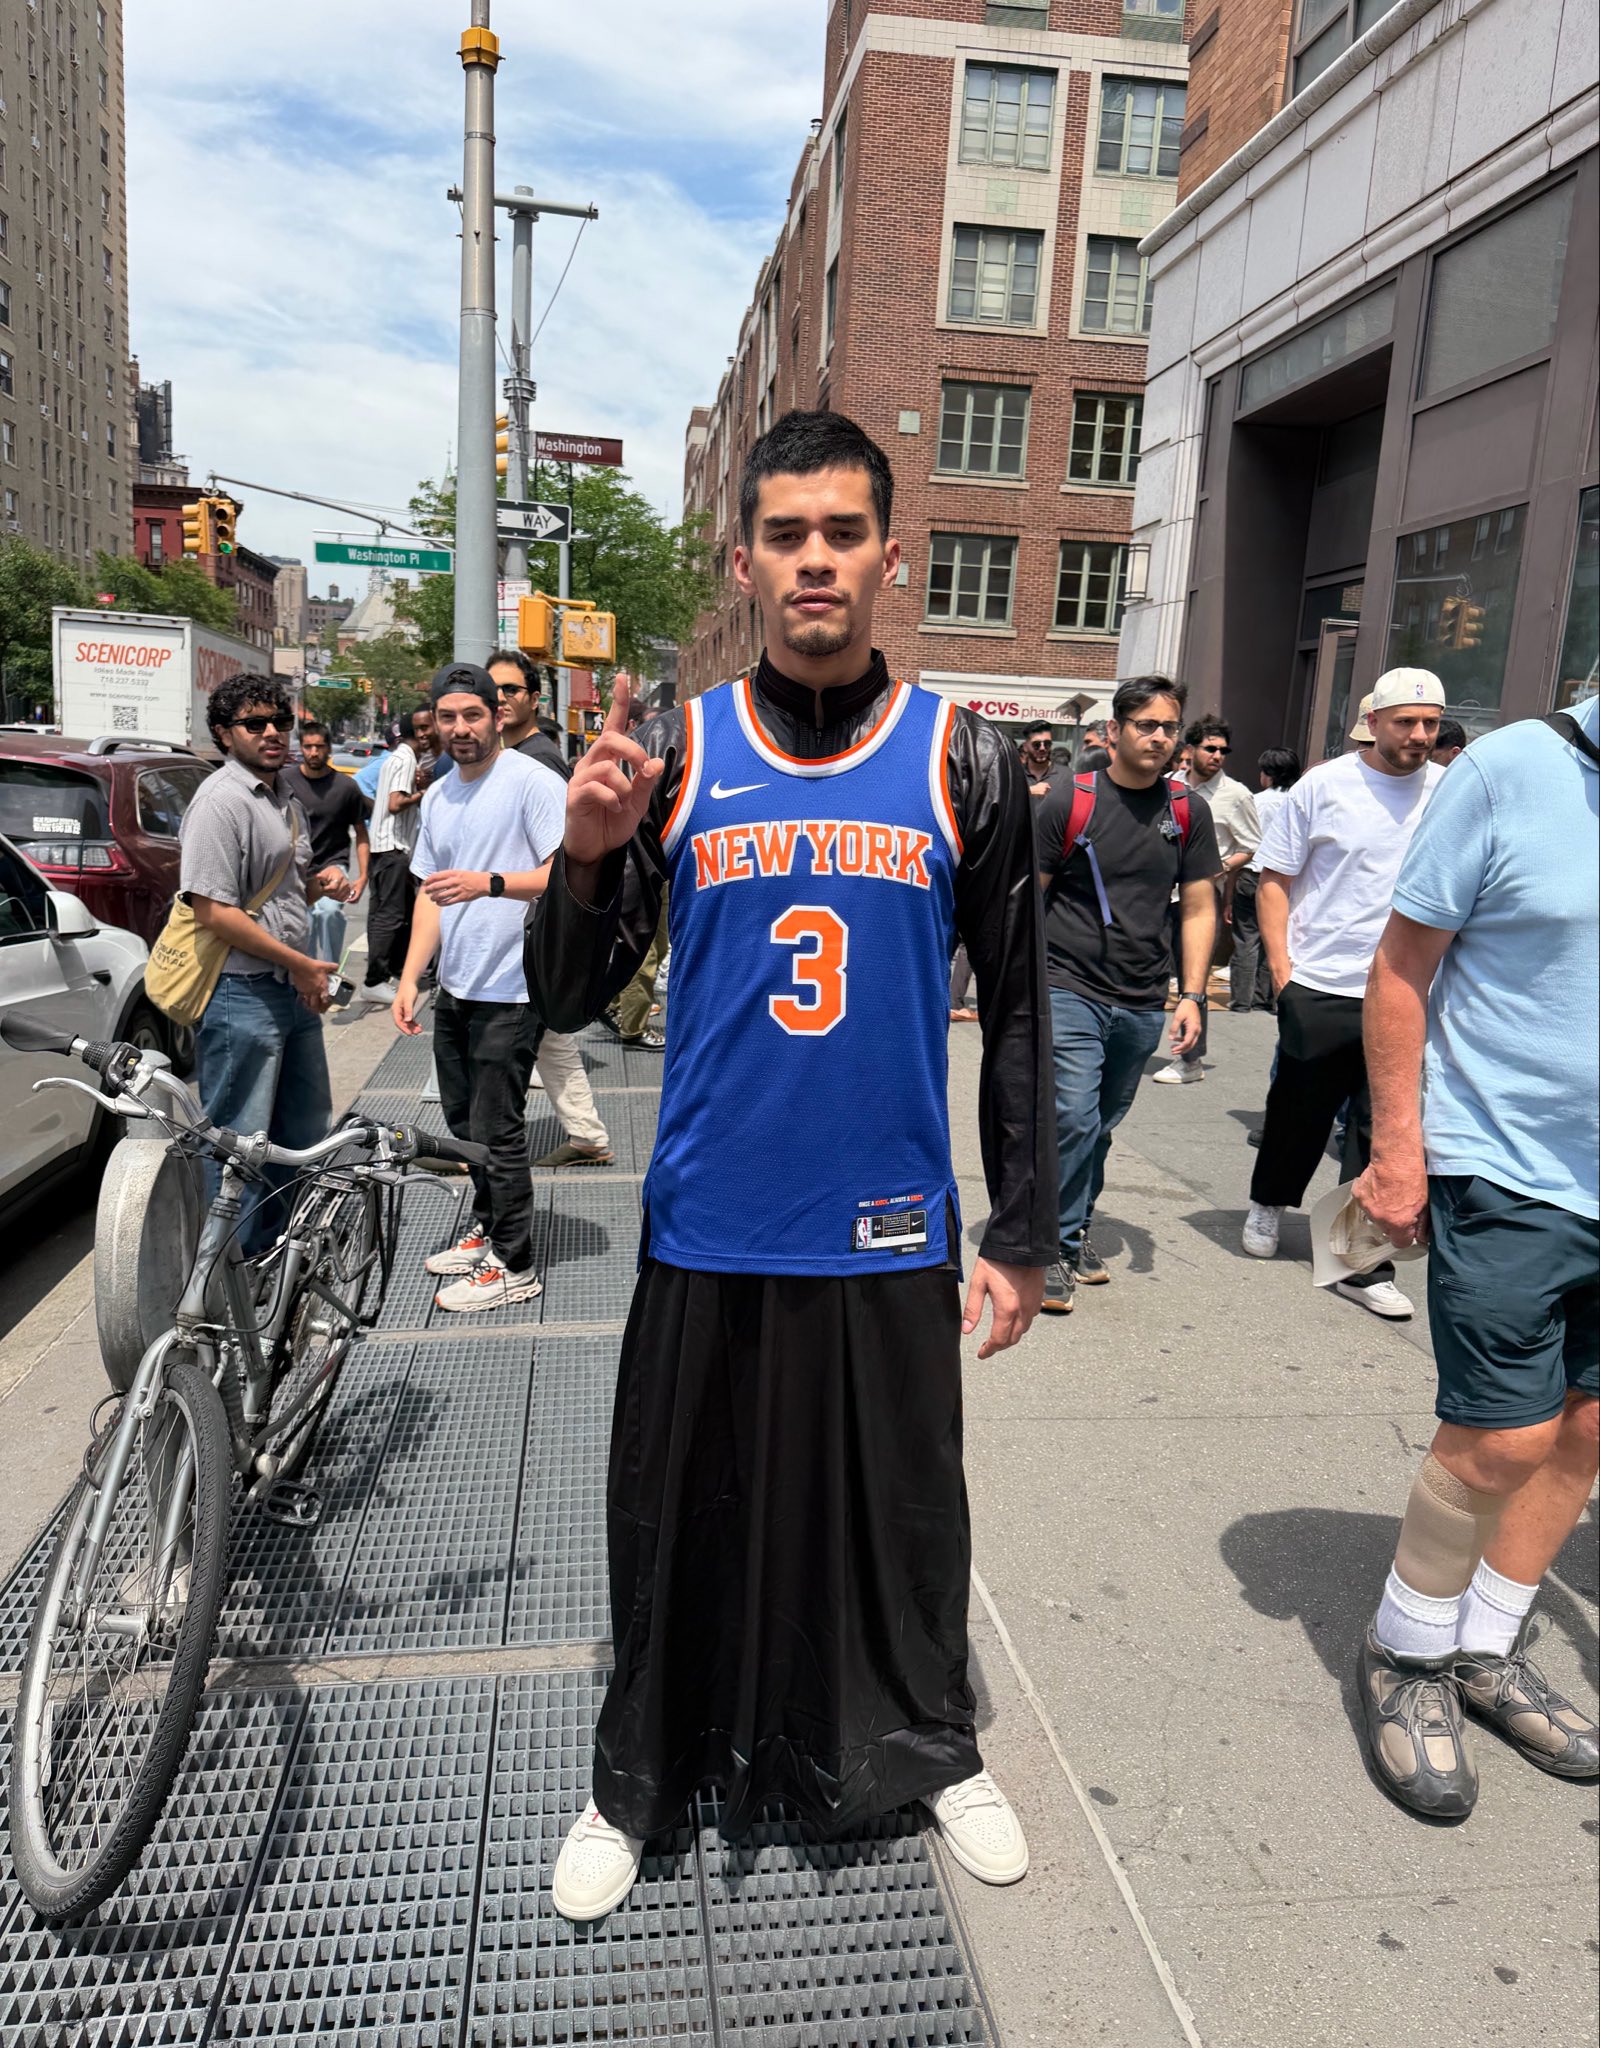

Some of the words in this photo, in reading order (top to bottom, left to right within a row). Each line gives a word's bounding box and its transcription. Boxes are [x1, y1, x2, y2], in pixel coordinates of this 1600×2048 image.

[537, 437, 602, 458] Washington
[522, 513, 552, 529] WAY
[348, 548, 406, 566] Washington
[410, 552, 420, 565] Pl
[76, 643, 171, 668] SCENICORP
[984, 701, 1019, 716] CVS
[690, 820, 801, 892] NEW
[802, 820, 933, 891] YORK
[769, 905, 849, 1036] 3
